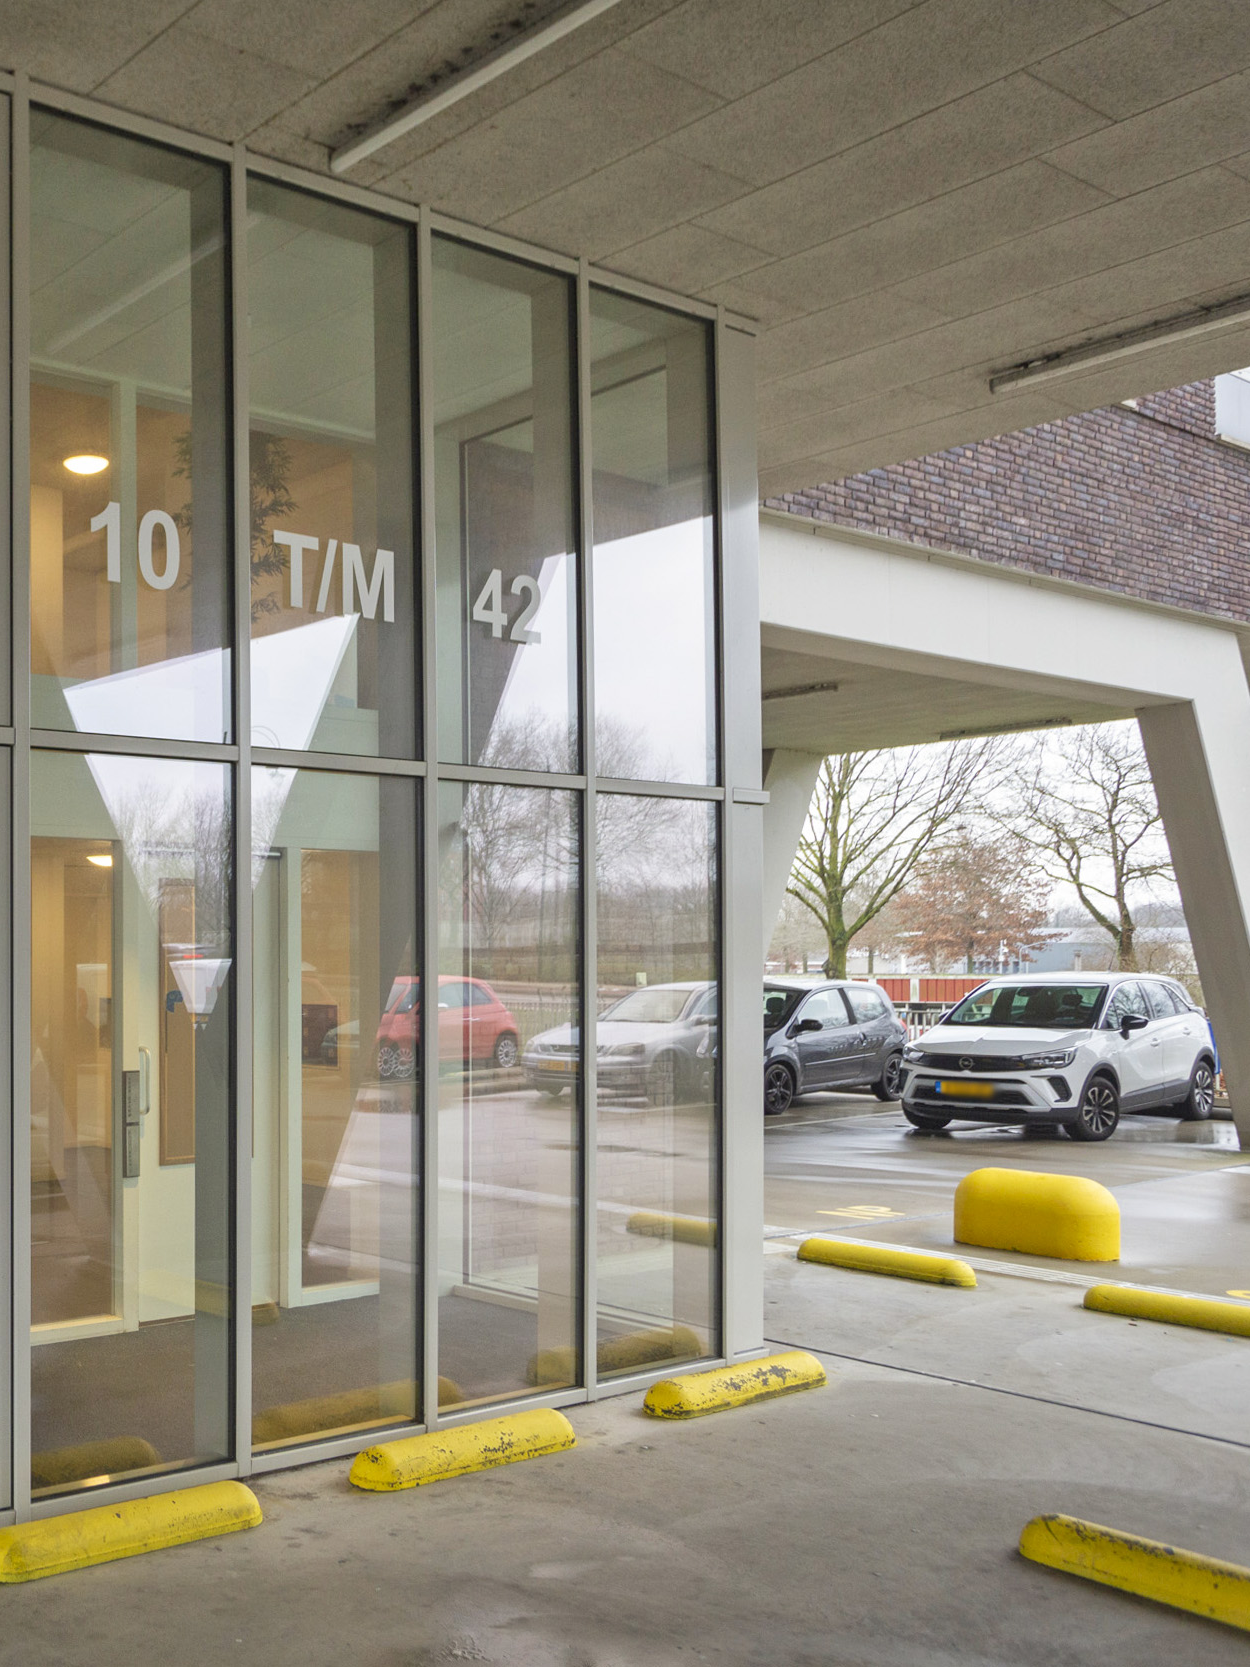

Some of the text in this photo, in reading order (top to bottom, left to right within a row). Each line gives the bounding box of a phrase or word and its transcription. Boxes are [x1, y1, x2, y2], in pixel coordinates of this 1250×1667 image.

[90, 501, 542, 645] 10 T/M 42
